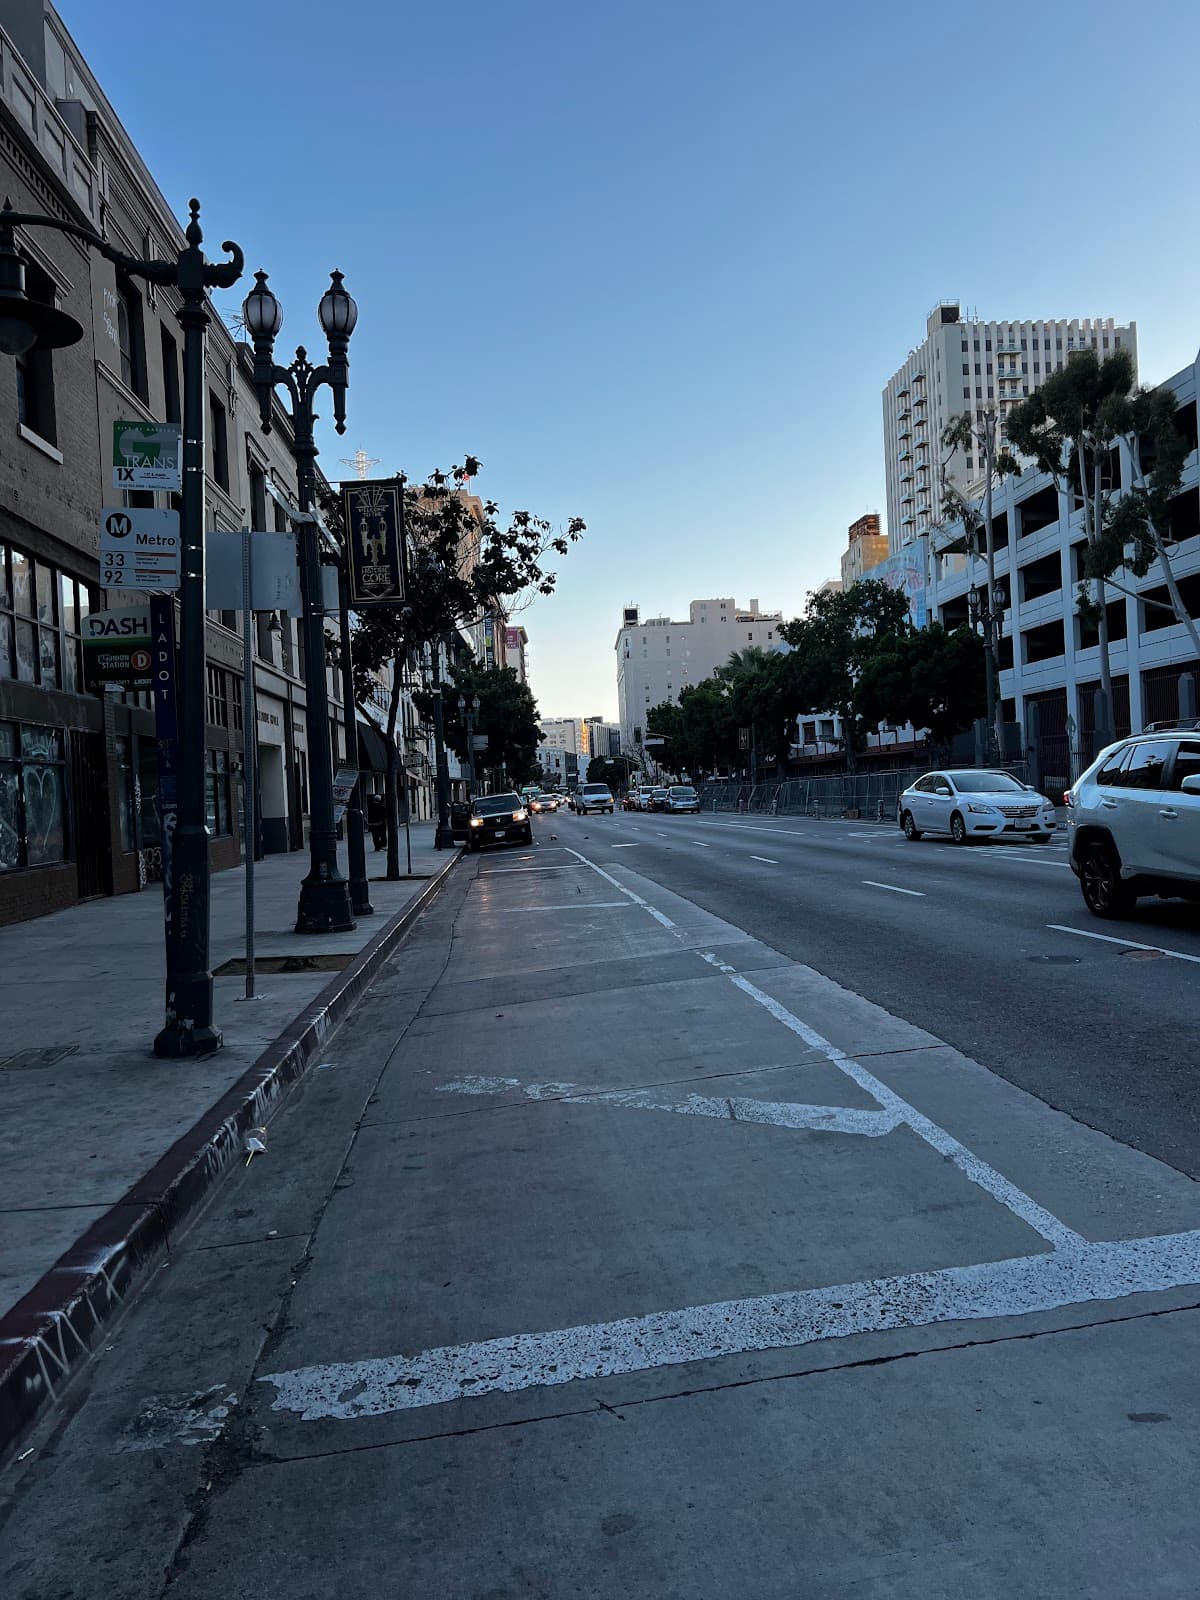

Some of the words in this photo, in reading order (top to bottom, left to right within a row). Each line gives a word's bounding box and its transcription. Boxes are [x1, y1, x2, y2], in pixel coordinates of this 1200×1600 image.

[125, 455, 175, 471] TRANS
[117, 468, 135, 481] 1X
[136, 534, 176, 546] Metro
[105, 553, 125, 566] 33
[104, 570, 123, 584] 92
[362, 574, 391, 583] CORE
[90, 617, 148, 636] DASH
[102, 661, 130, 670] STATION
